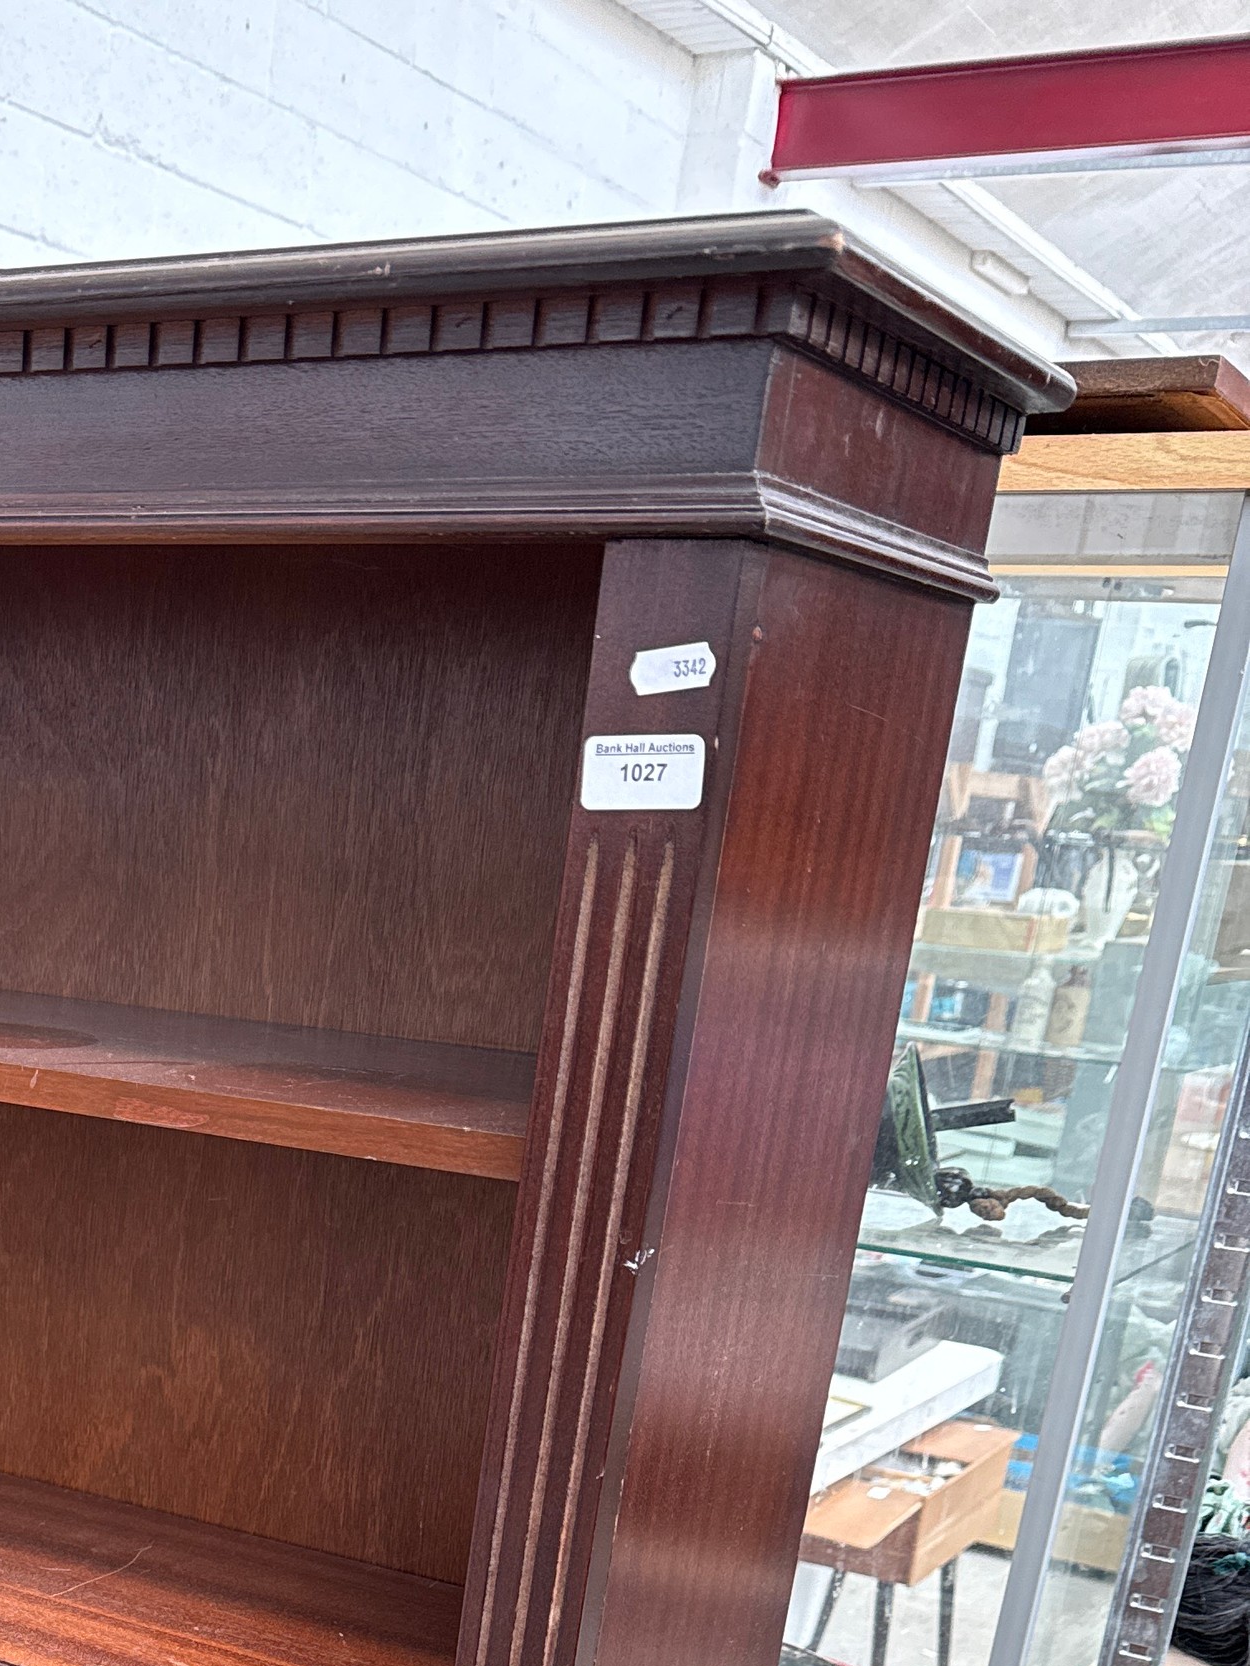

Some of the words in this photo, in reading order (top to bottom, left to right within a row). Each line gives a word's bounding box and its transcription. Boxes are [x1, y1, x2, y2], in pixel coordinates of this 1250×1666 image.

[673, 657, 707, 678] 3342
[596, 743, 623, 754] Bank
[625, 742, 646, 753] Hall
[648, 741, 695, 753] Auctions
[620, 763, 668, 782] 1027
